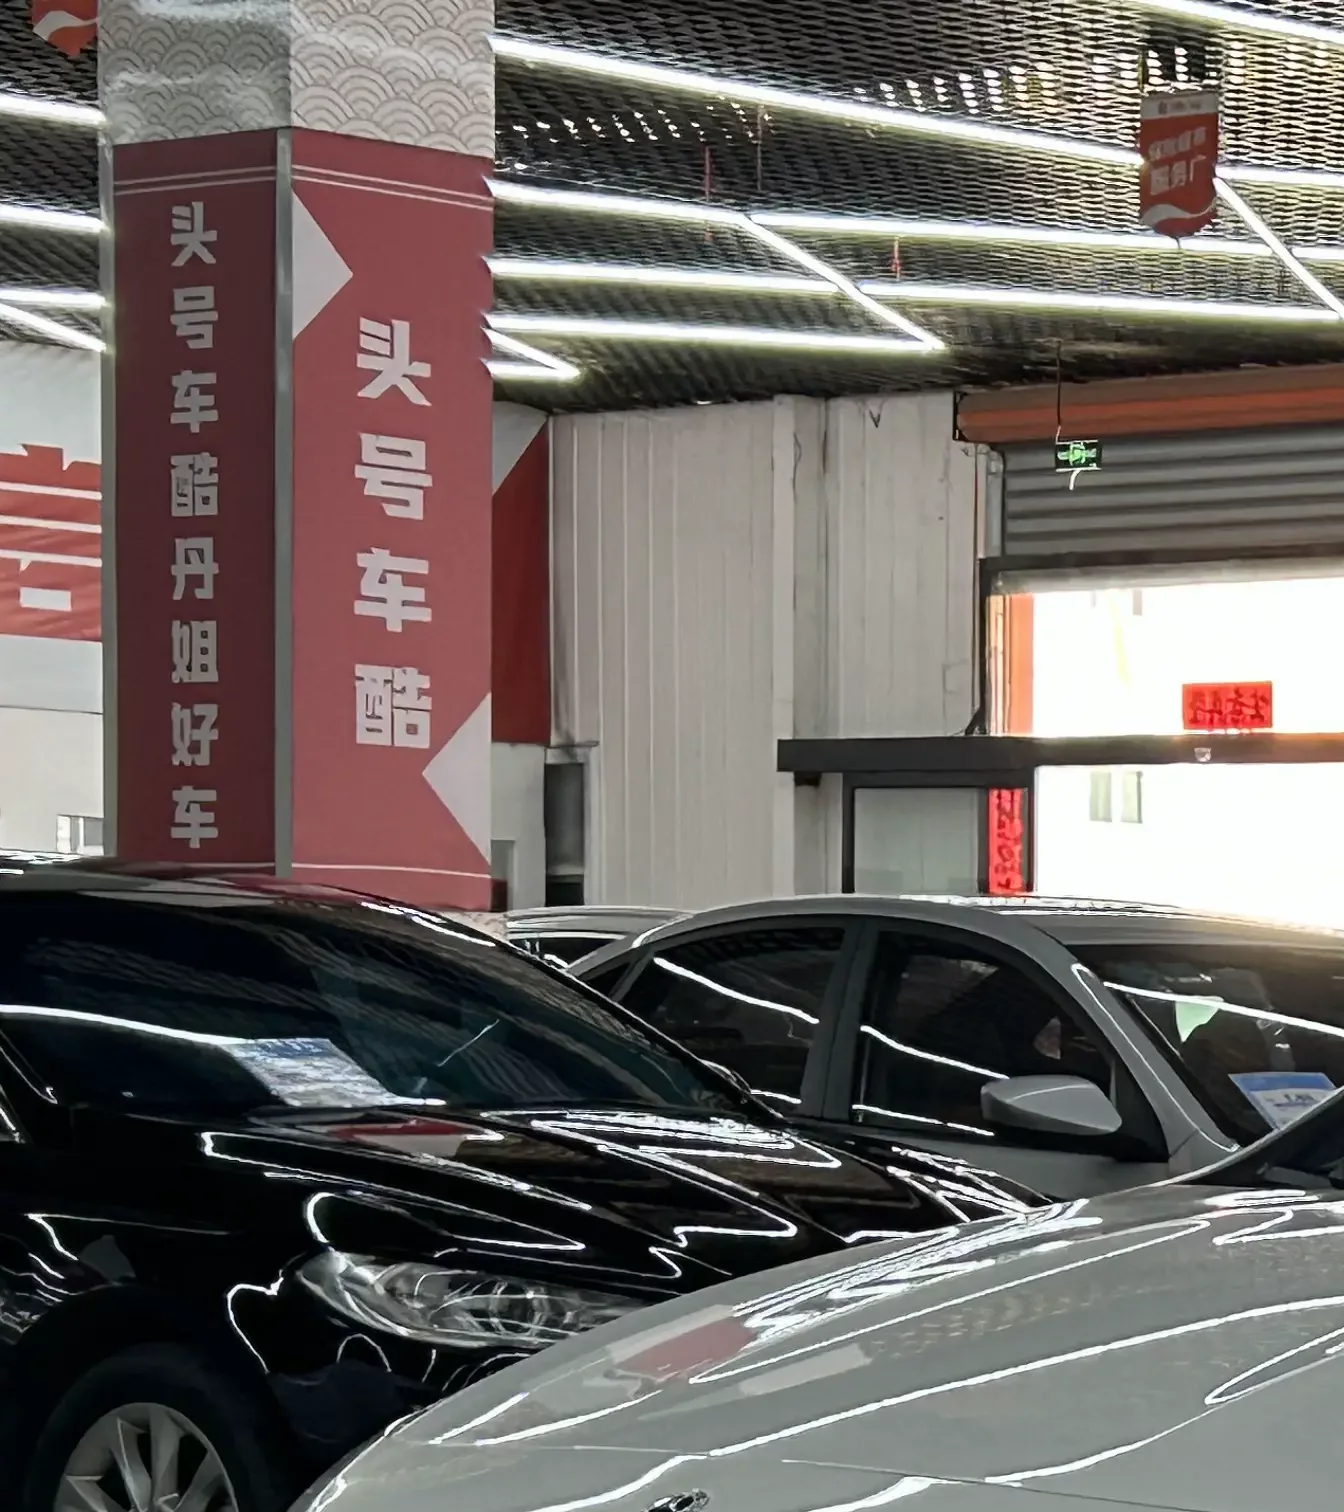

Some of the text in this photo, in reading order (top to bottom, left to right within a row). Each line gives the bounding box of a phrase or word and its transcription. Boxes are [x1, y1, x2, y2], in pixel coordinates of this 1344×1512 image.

[170, 202, 219, 849] 头号车酷丹姐好车
[354, 318, 433, 749] 头号车酷
